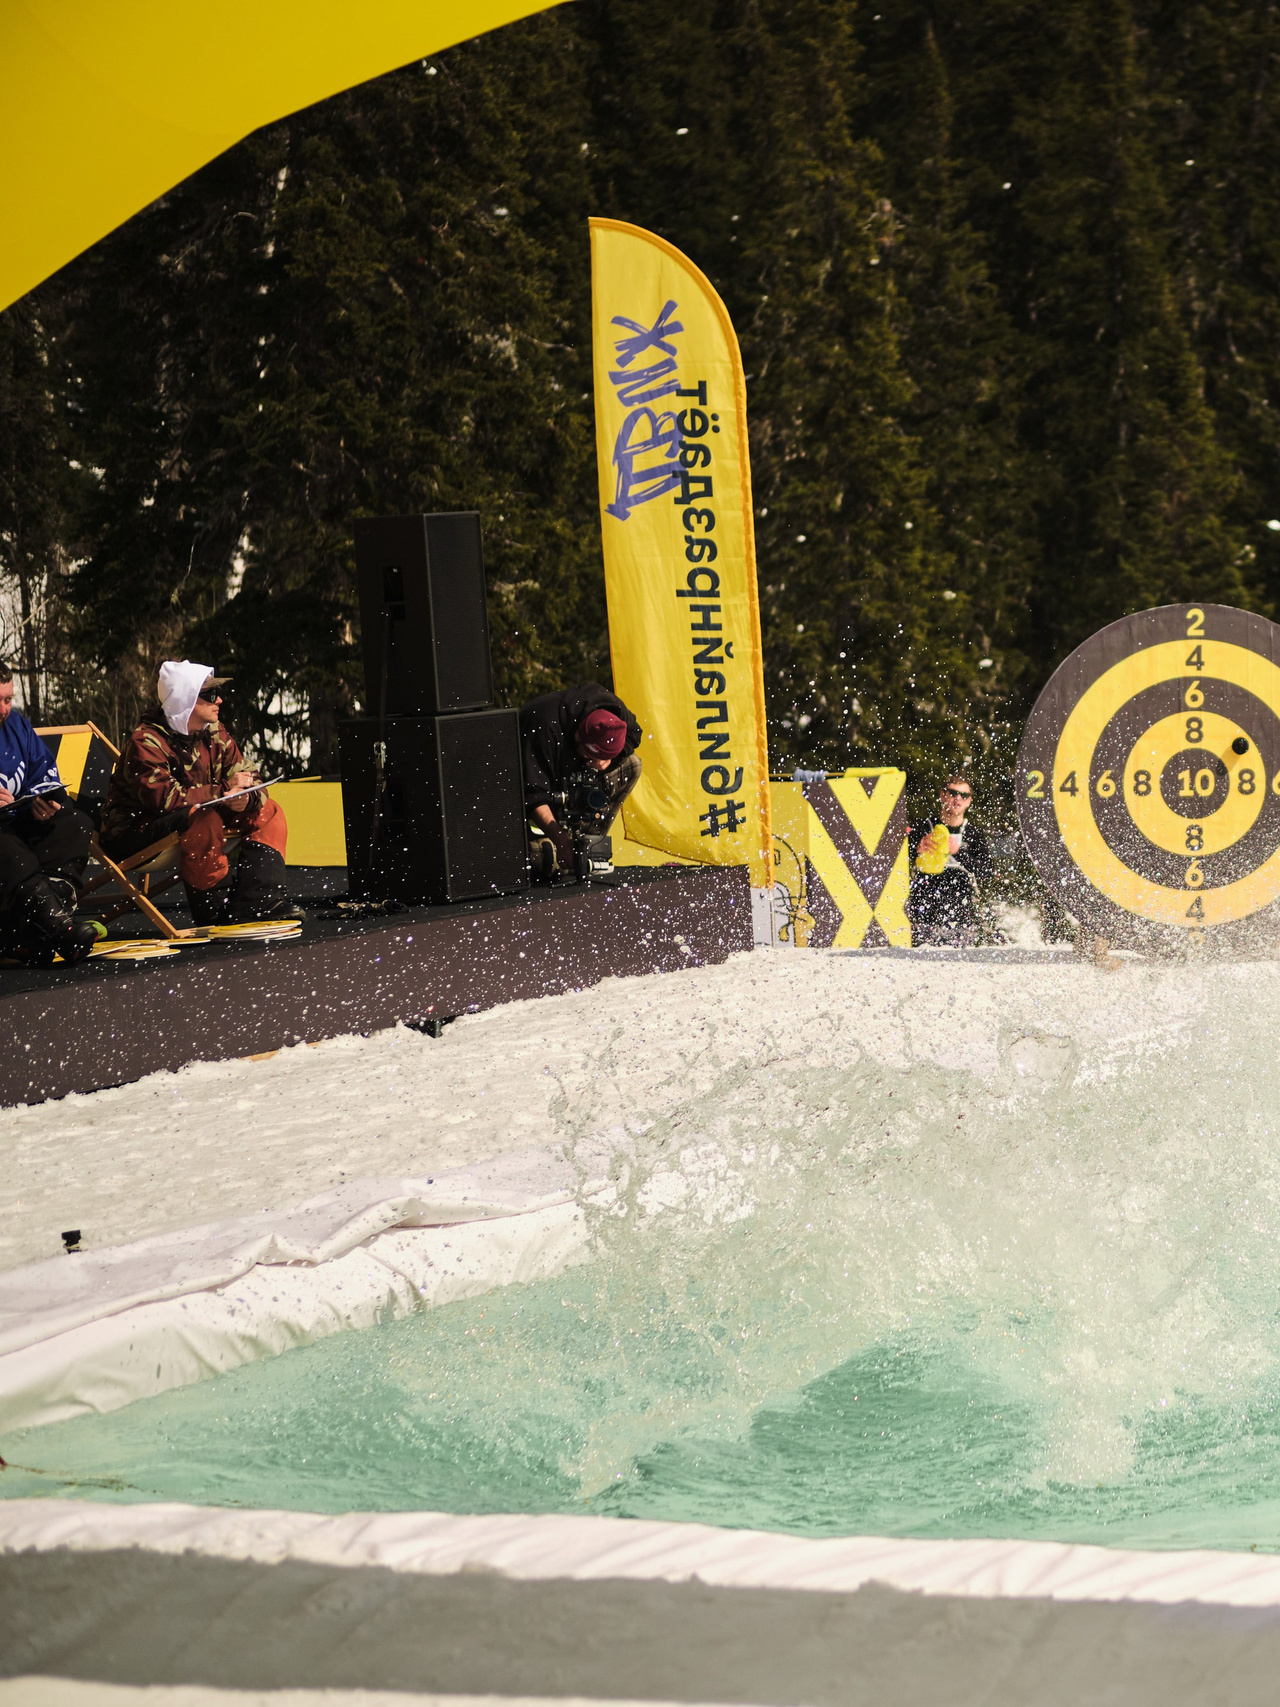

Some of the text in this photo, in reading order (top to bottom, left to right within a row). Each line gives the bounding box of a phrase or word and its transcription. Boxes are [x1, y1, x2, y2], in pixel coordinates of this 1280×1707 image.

[1185, 608, 1205, 637] 2
[1185, 645, 1205, 672] 4
[1185, 681, 1205, 708] 6
[1185, 716, 1205, 744] 8
[1026, 771, 1045, 799] 2
[1059, 771, 1080, 798] 4
[1096, 770, 1116, 798] 6
[1133, 770, 1152, 797] 8
[1177, 769, 1215, 797] 10
[1237, 769, 1256, 796] 8
[1185, 824, 1205, 852] 8
[1185, 861, 1205, 888] 6
[1185, 896, 1205, 923] 4
